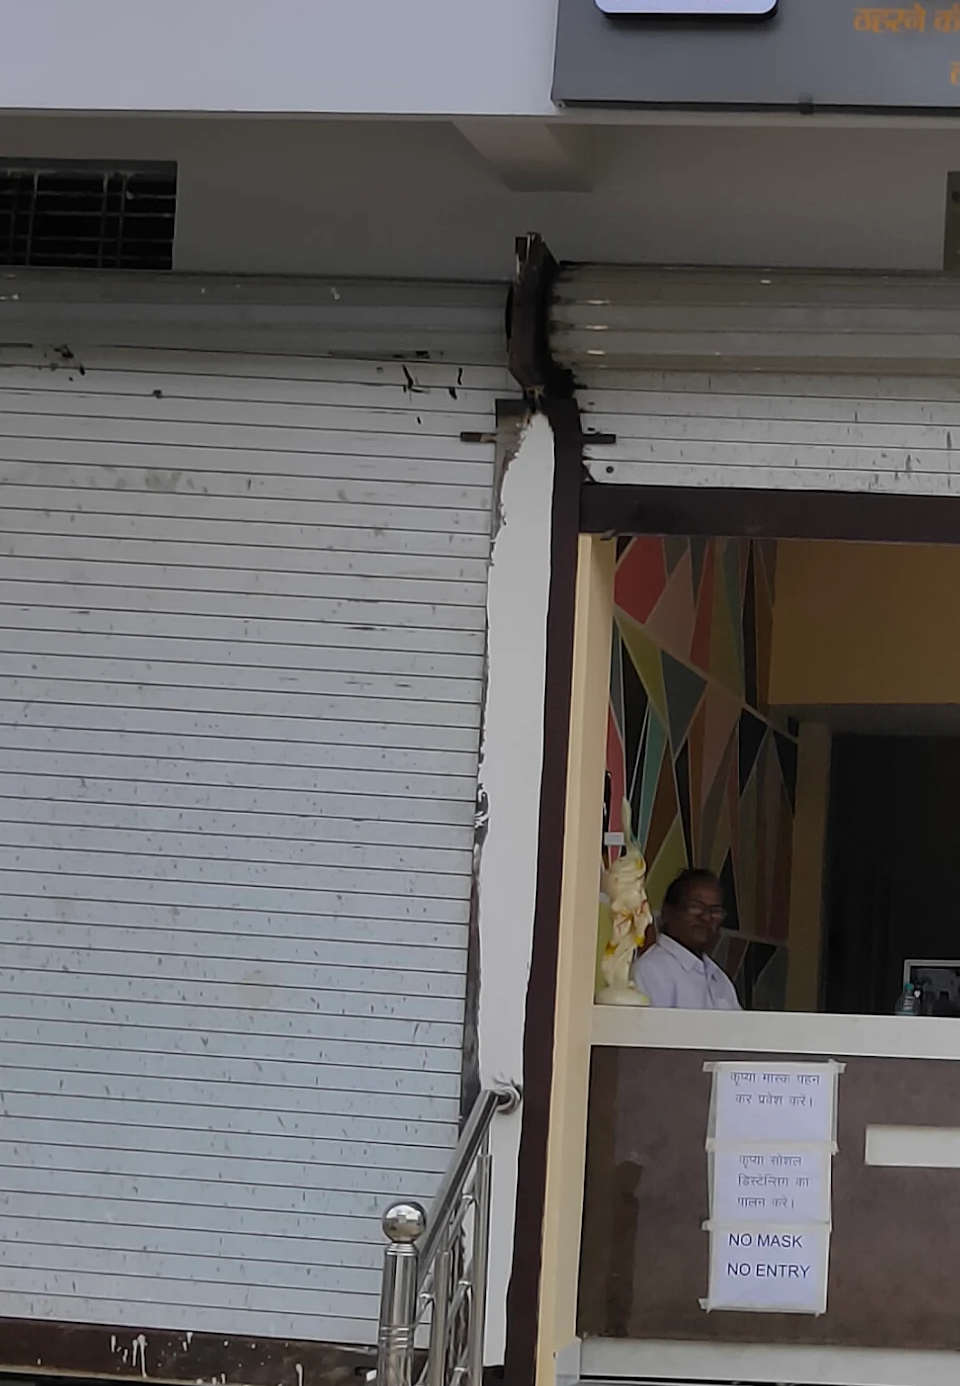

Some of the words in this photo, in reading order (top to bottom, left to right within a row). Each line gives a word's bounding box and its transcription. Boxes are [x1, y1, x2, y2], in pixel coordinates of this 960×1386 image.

[729, 1233, 752, 1246] NO
[757, 1233, 803, 1248] MASK
[727, 1263, 751, 1276] NO
[756, 1263, 810, 1278] ENTRY
